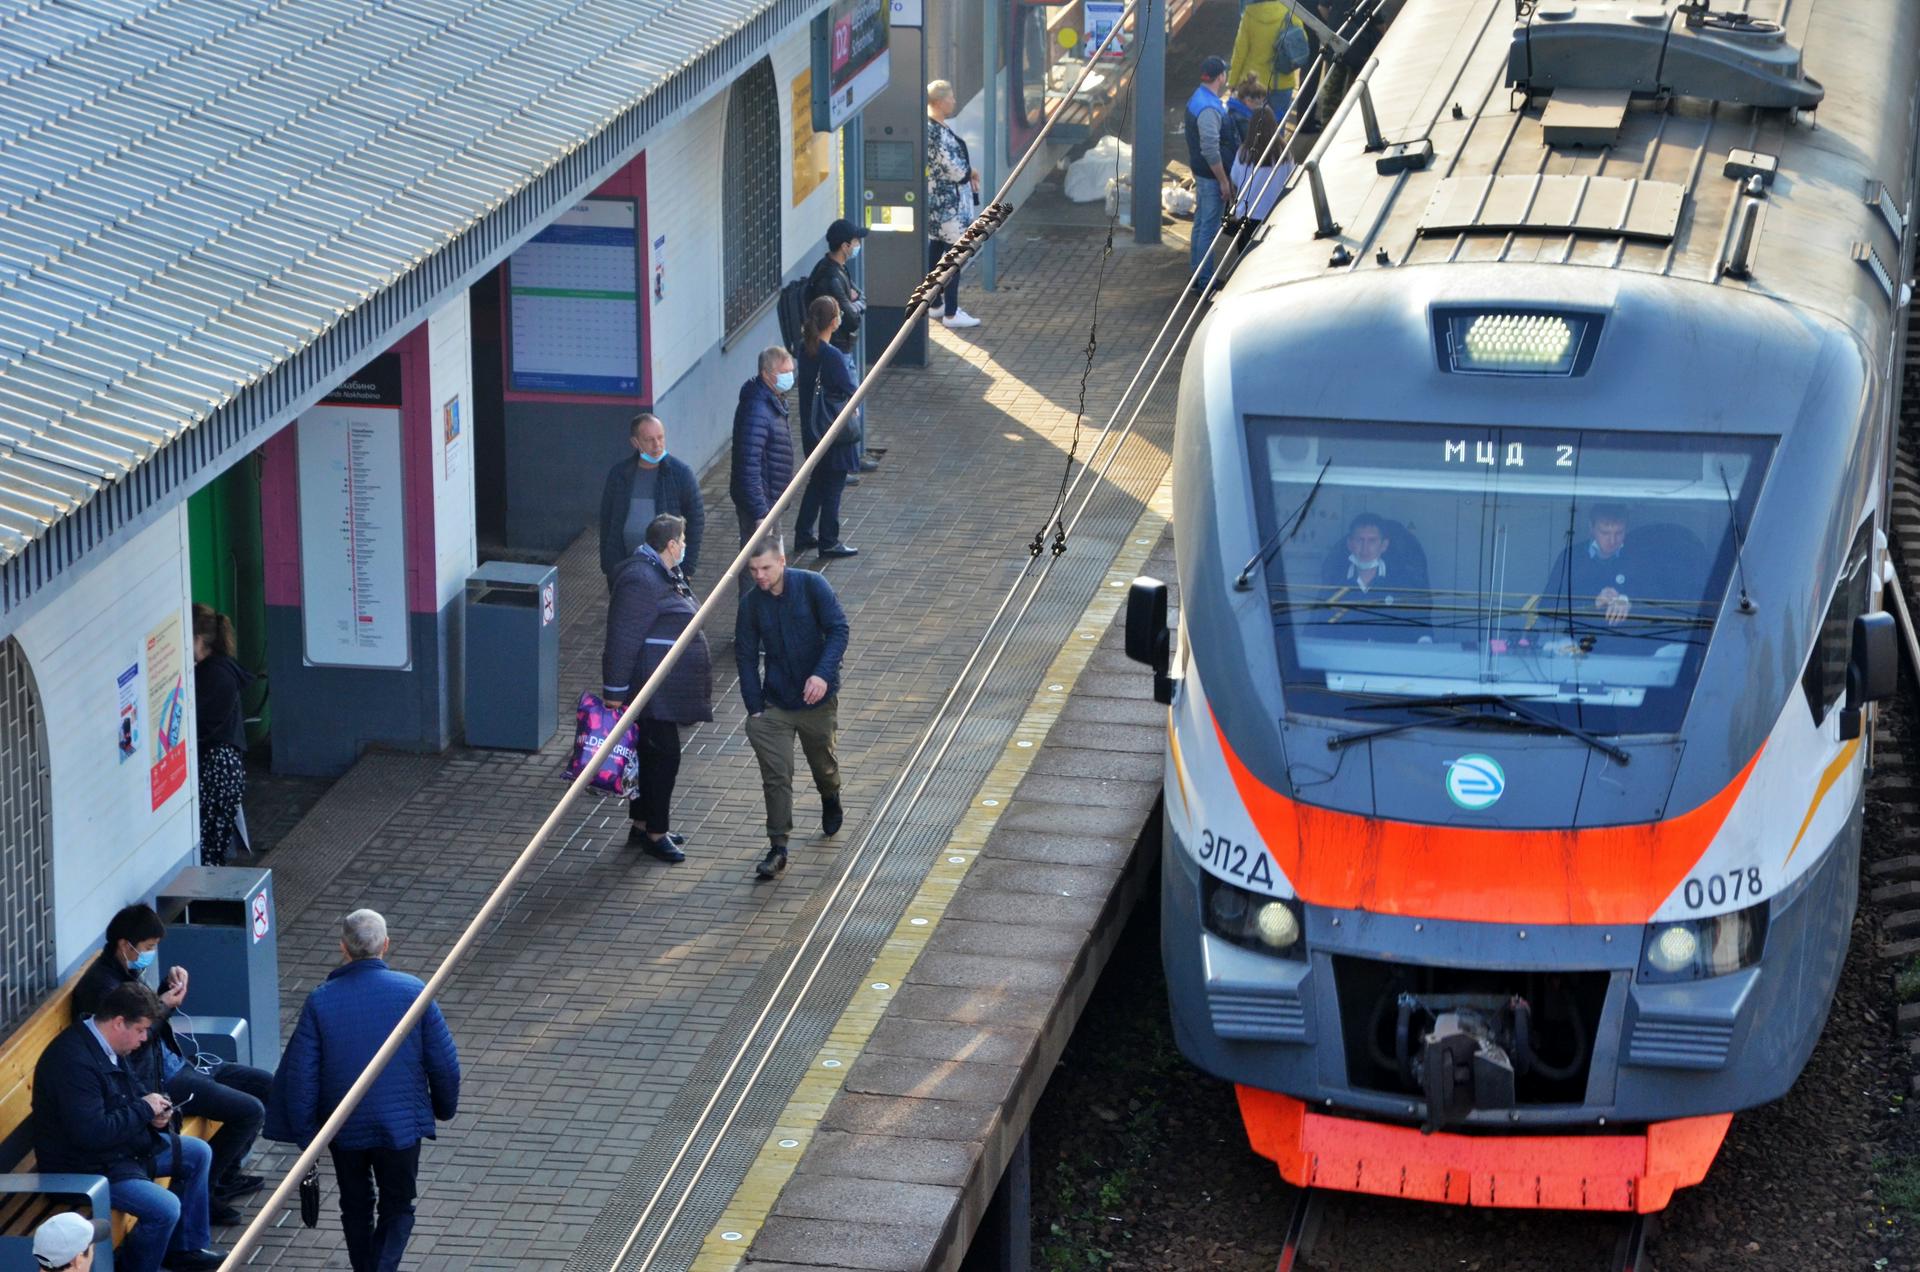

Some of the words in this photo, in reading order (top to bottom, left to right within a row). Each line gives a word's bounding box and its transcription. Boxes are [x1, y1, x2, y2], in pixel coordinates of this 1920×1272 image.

[835, 25, 849, 59] D2
[1445, 440, 1524, 466] МЦД
[1556, 445, 1572, 466] 2
[1199, 829, 1273, 889] ЭП2Д
[1684, 867, 1762, 909] 0078
